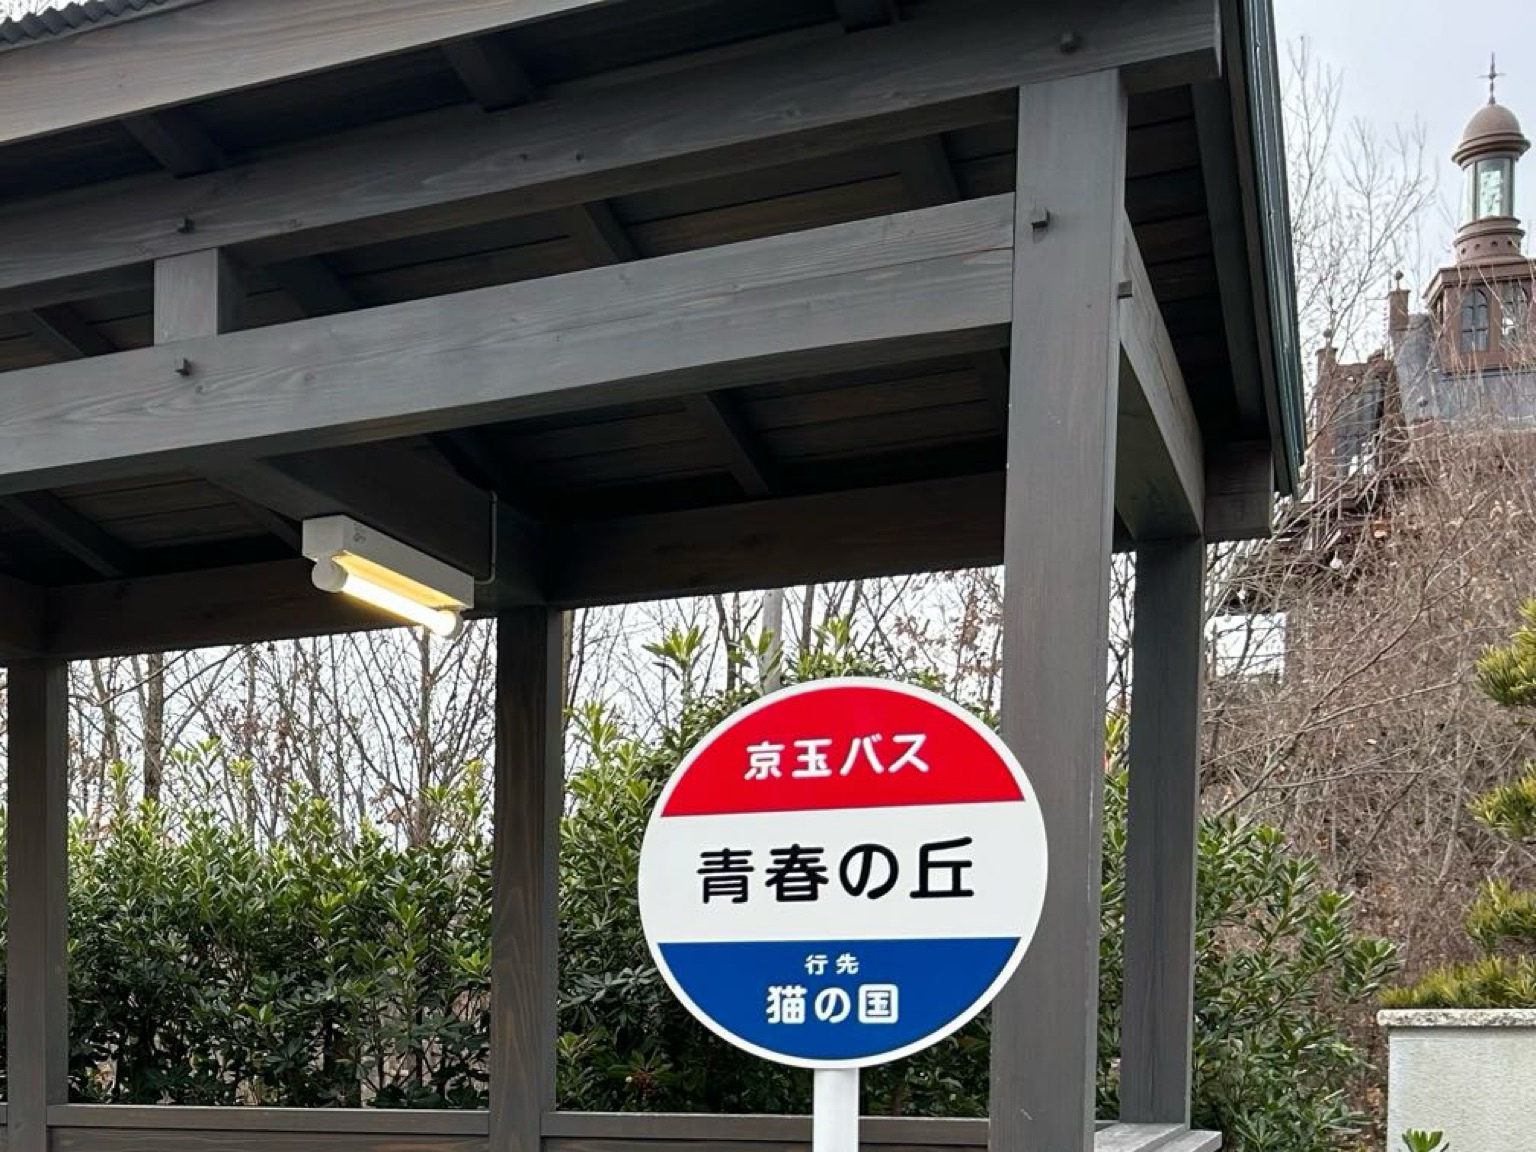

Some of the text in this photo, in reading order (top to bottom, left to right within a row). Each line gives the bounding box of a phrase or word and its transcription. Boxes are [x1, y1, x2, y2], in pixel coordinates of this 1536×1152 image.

[743, 732, 931, 781] 京玉バス
[696, 836, 975, 904] 青春の丘
[804, 953, 860, 975] 行先
[765, 983, 900, 1025] 猫の国
